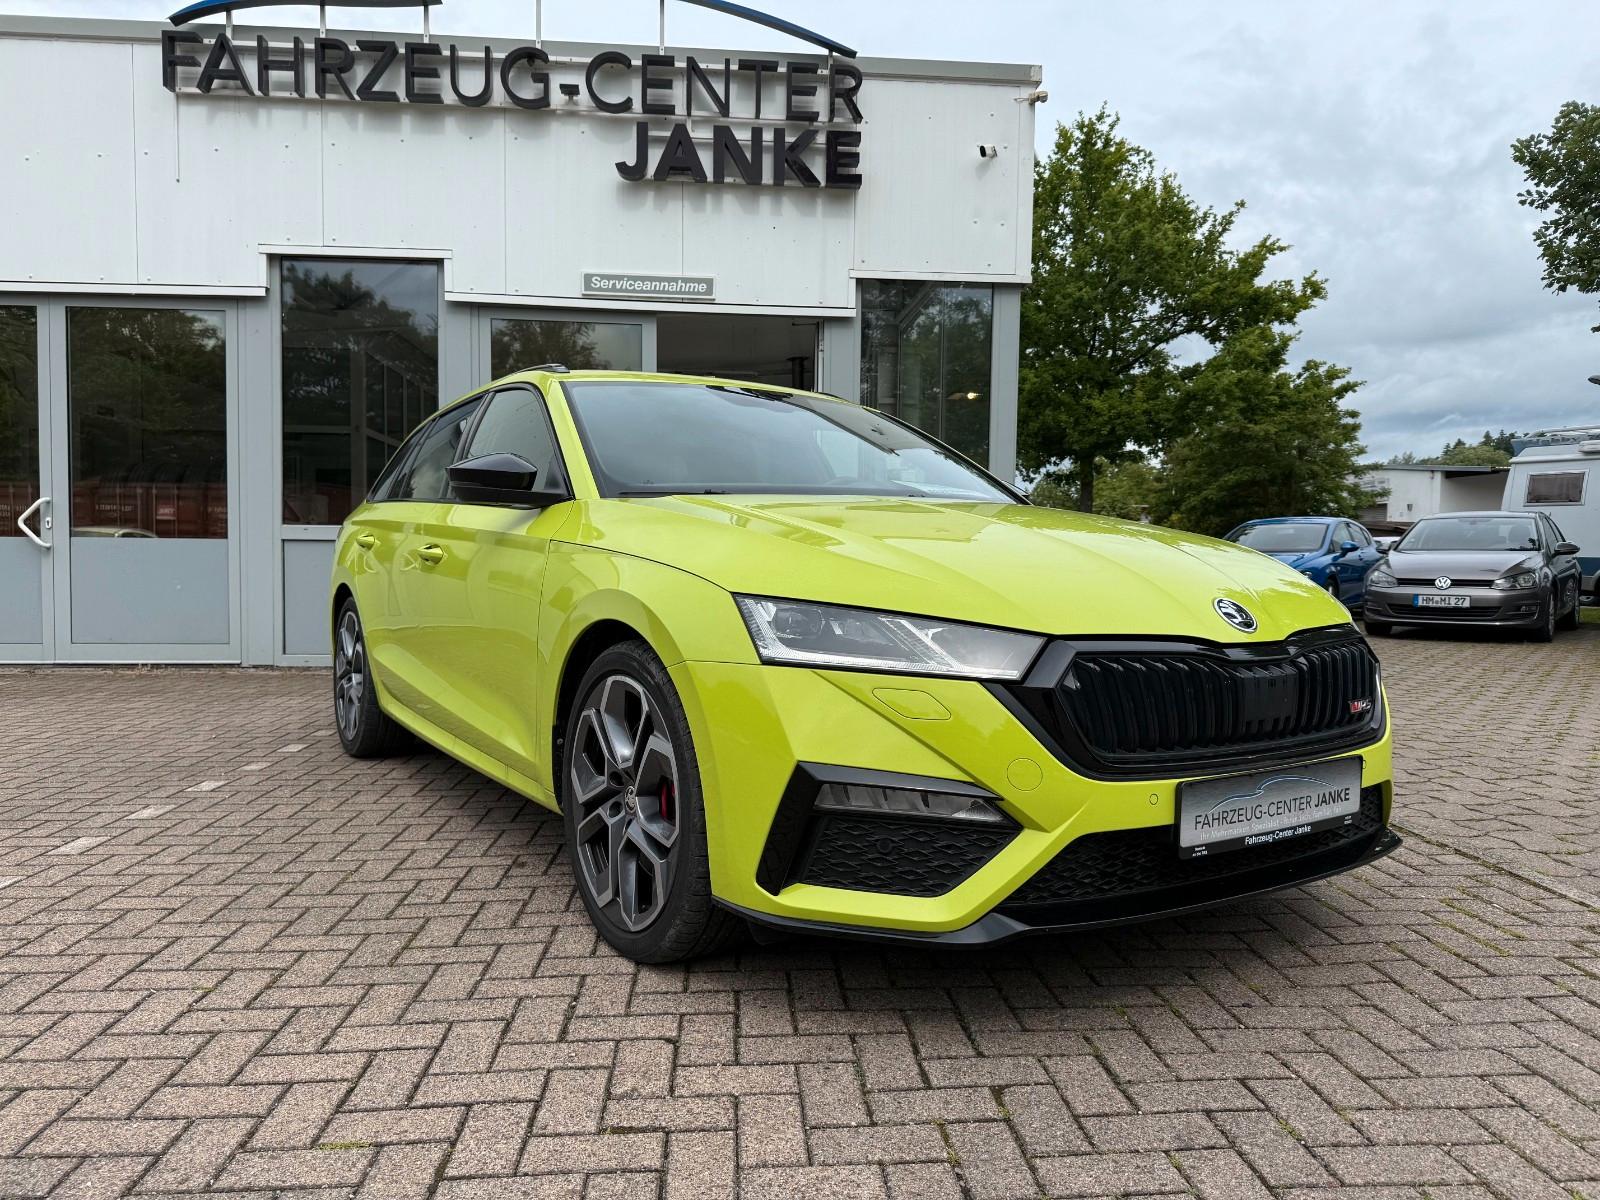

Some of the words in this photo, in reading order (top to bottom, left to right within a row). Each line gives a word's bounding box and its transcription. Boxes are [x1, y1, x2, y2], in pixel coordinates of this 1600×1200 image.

[162, 29, 863, 124] FAHRZEUG-CENTER
[614, 121, 863, 189] JANKE
[590, 276, 707, 292] Serviceannahme
[1454, 597, 1466, 606] 27
[1194, 795, 1312, 831] FAHRZEUG-CENTER
[1314, 787, 1351, 808] JANKE
[1245, 828, 1294, 846] Fahrzeug-Center
[1294, 824, 1312, 836] Janke
